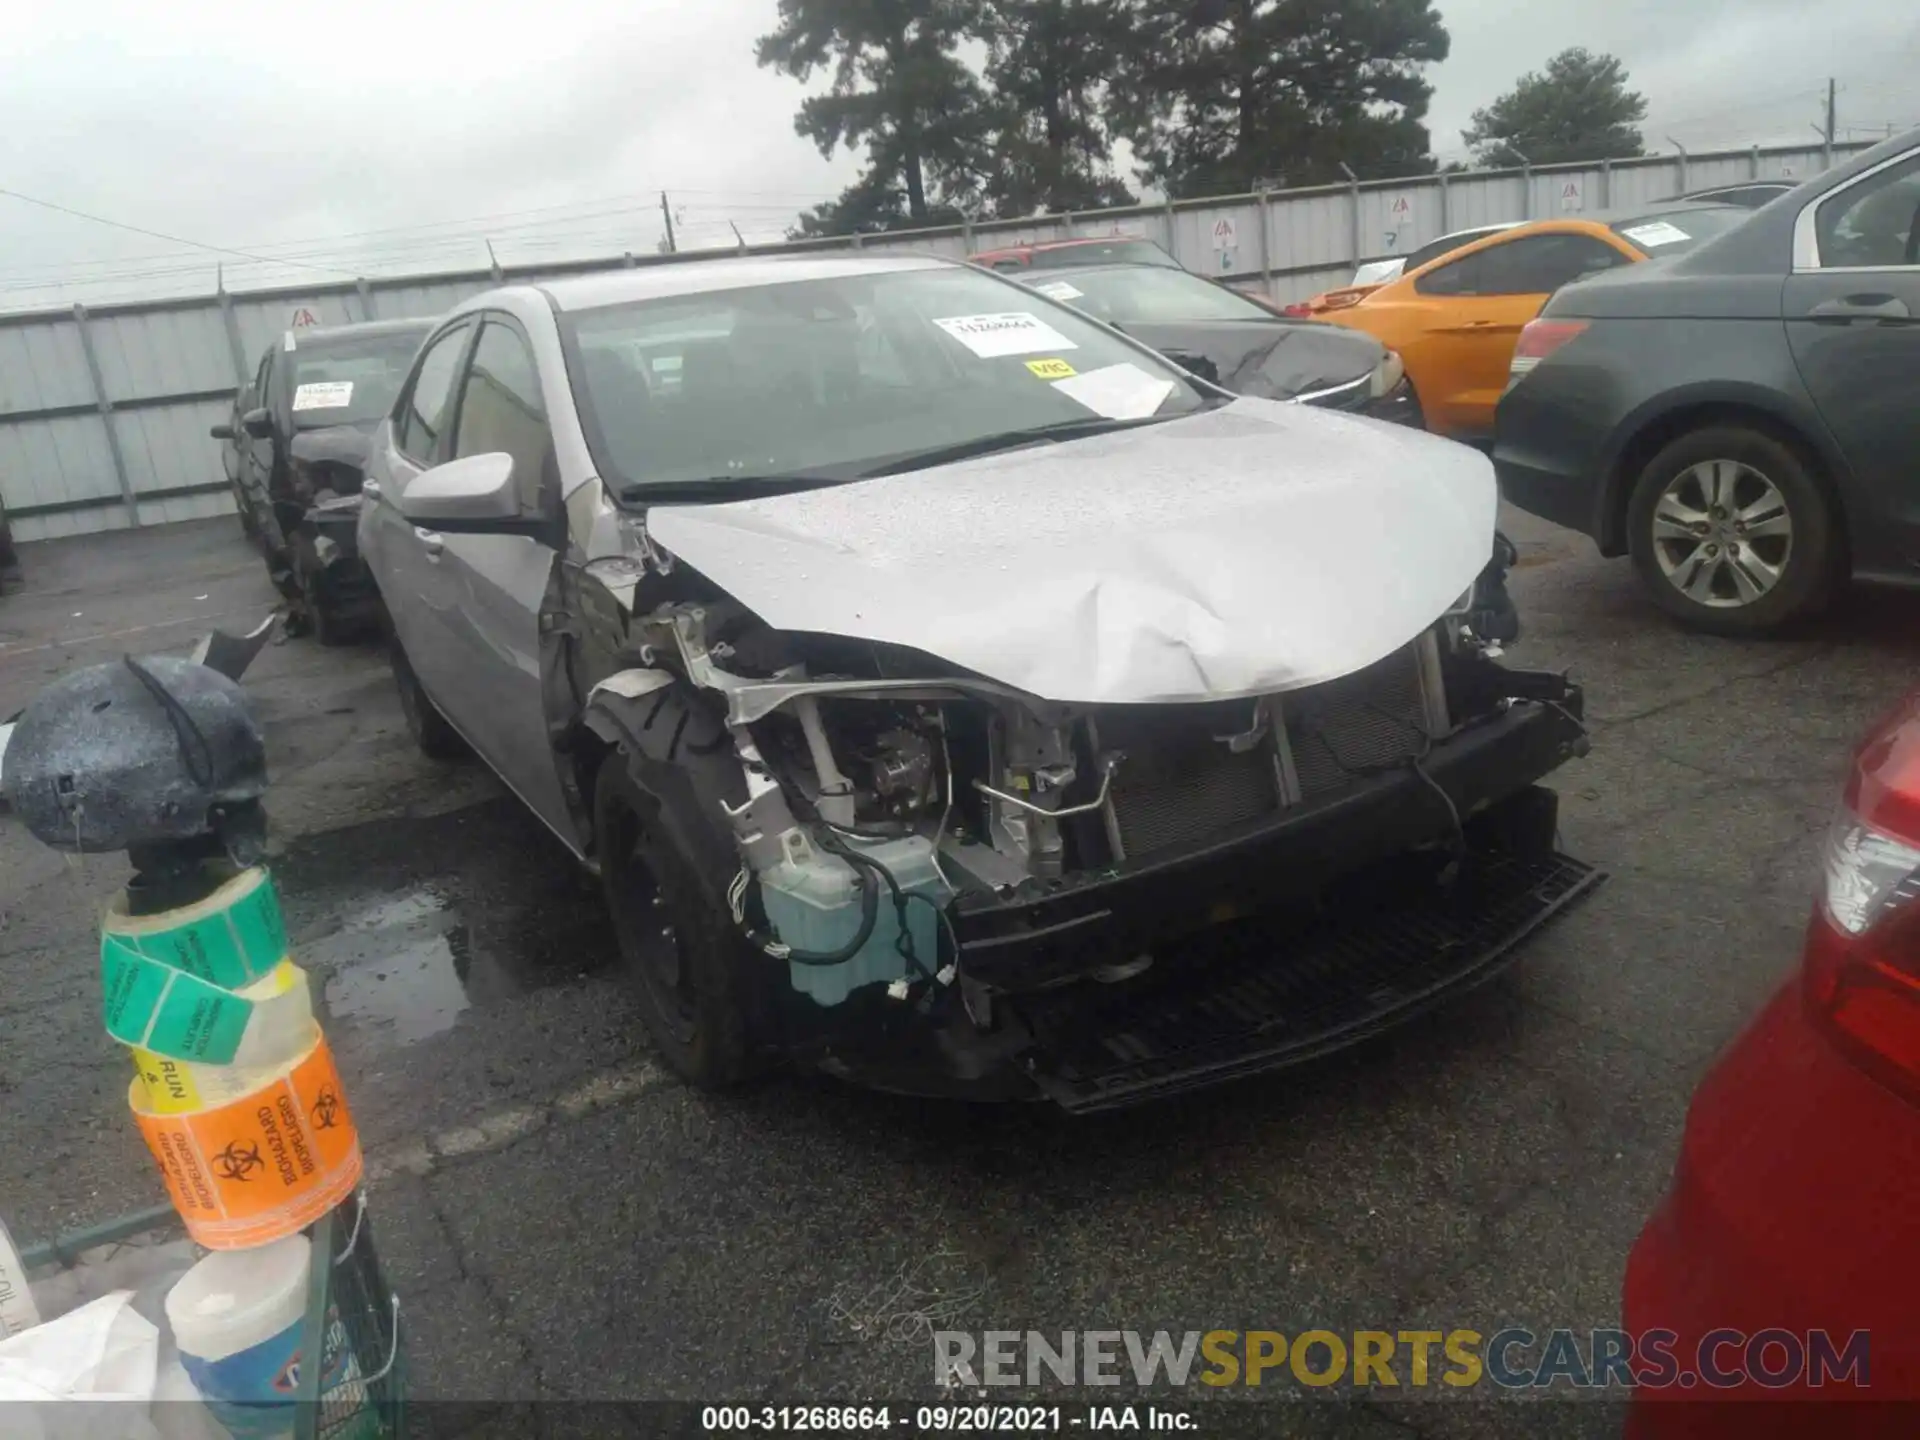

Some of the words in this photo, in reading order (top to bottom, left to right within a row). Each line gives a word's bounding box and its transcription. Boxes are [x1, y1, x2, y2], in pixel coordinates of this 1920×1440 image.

[158, 1060, 188, 1099] RUN
[258, 1106, 298, 1187] BIOHAZARD
[277, 1094, 315, 1176] BIOPELIGRO
